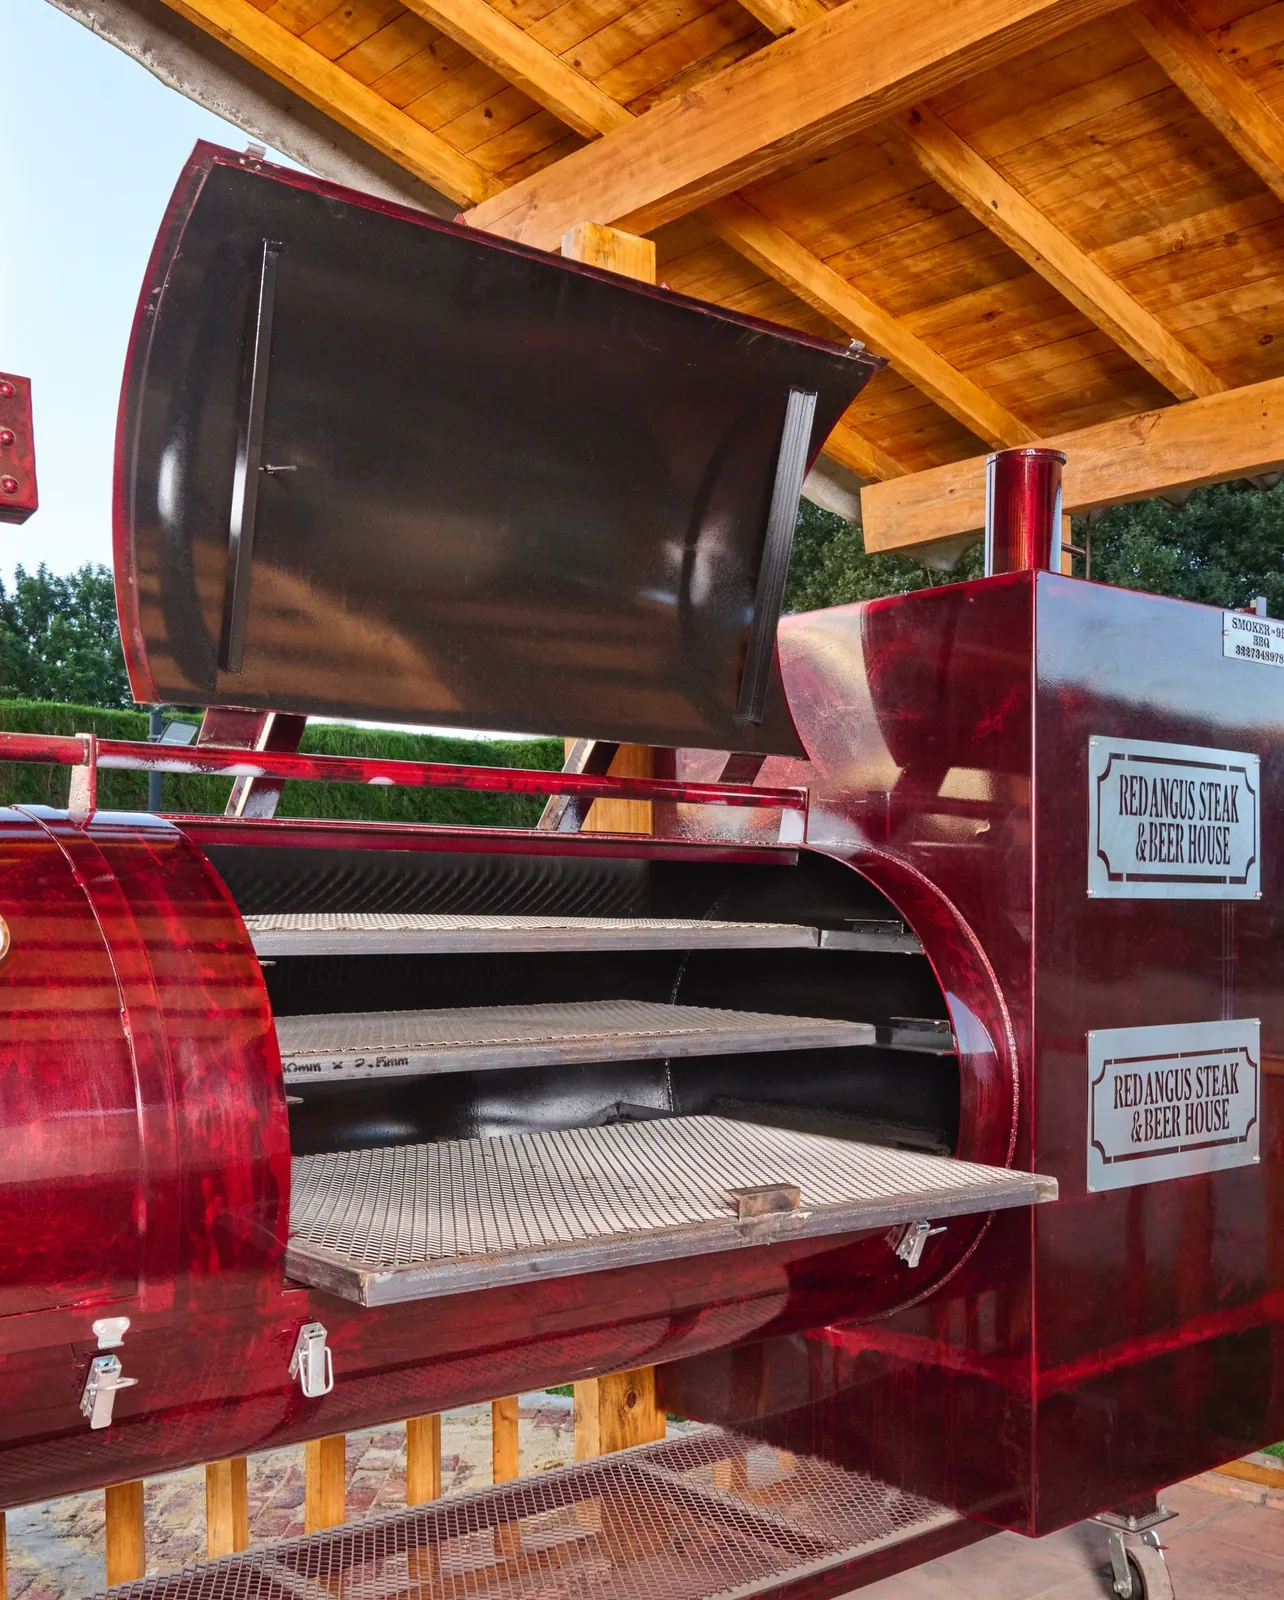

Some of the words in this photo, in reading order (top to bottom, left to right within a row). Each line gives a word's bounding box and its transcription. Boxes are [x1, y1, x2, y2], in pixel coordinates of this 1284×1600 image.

[1253, 635, 1270, 649] BBQ
[1199, 782, 1239, 824] STEAK
[1188, 824, 1230, 866] HOUSE
[1195, 1062, 1239, 1099] STEAK
[1185, 1098, 1230, 1136] HOUSE
